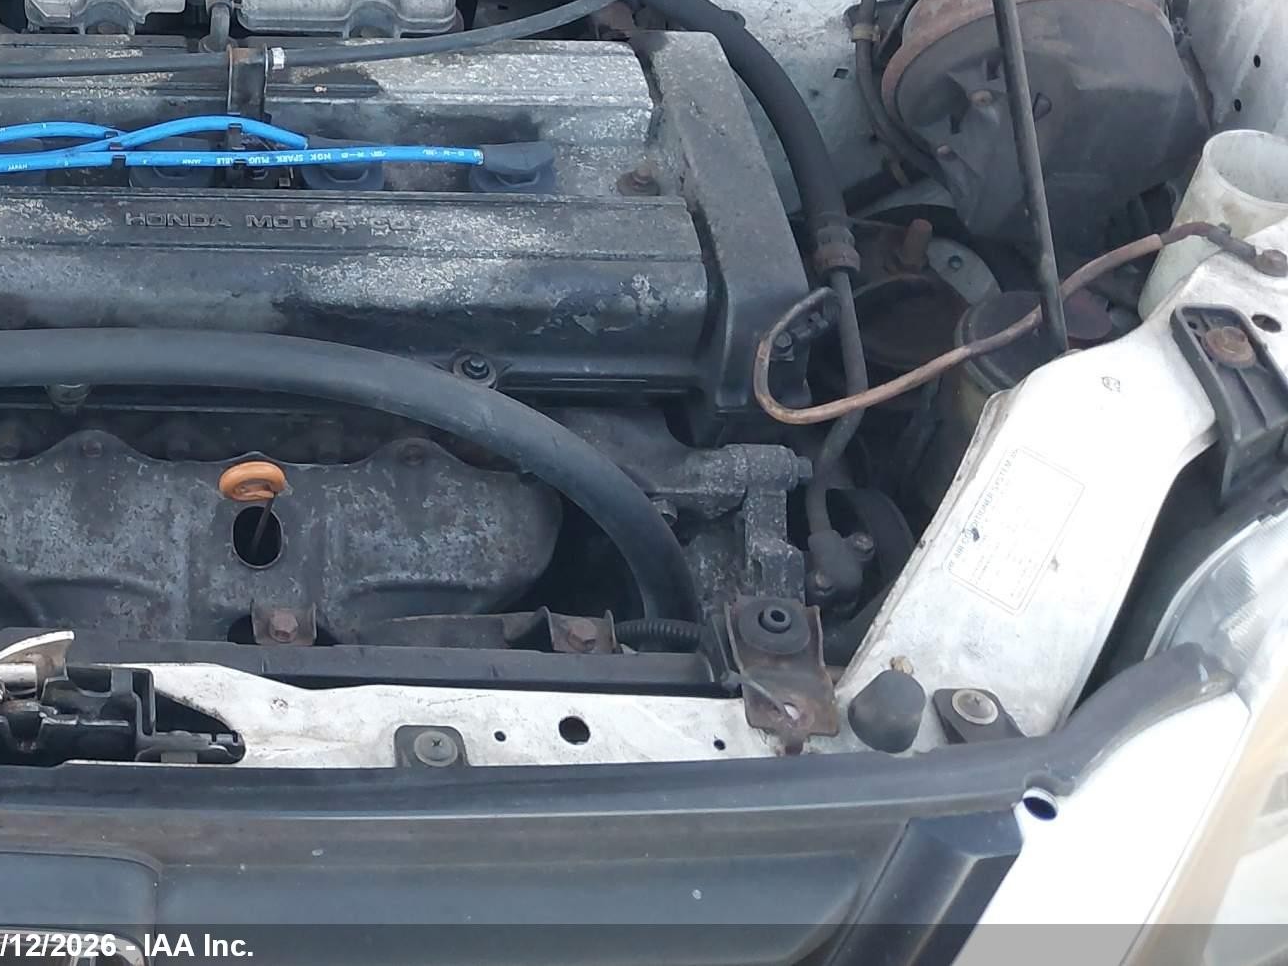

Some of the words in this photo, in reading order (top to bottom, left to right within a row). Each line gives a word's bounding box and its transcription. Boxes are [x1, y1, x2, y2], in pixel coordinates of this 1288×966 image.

[216, 157, 233, 165] ABLE
[248, 156, 269, 164] PLUG
[275, 154, 304, 163] SPARK
[124, 212, 231, 228] HONDA
